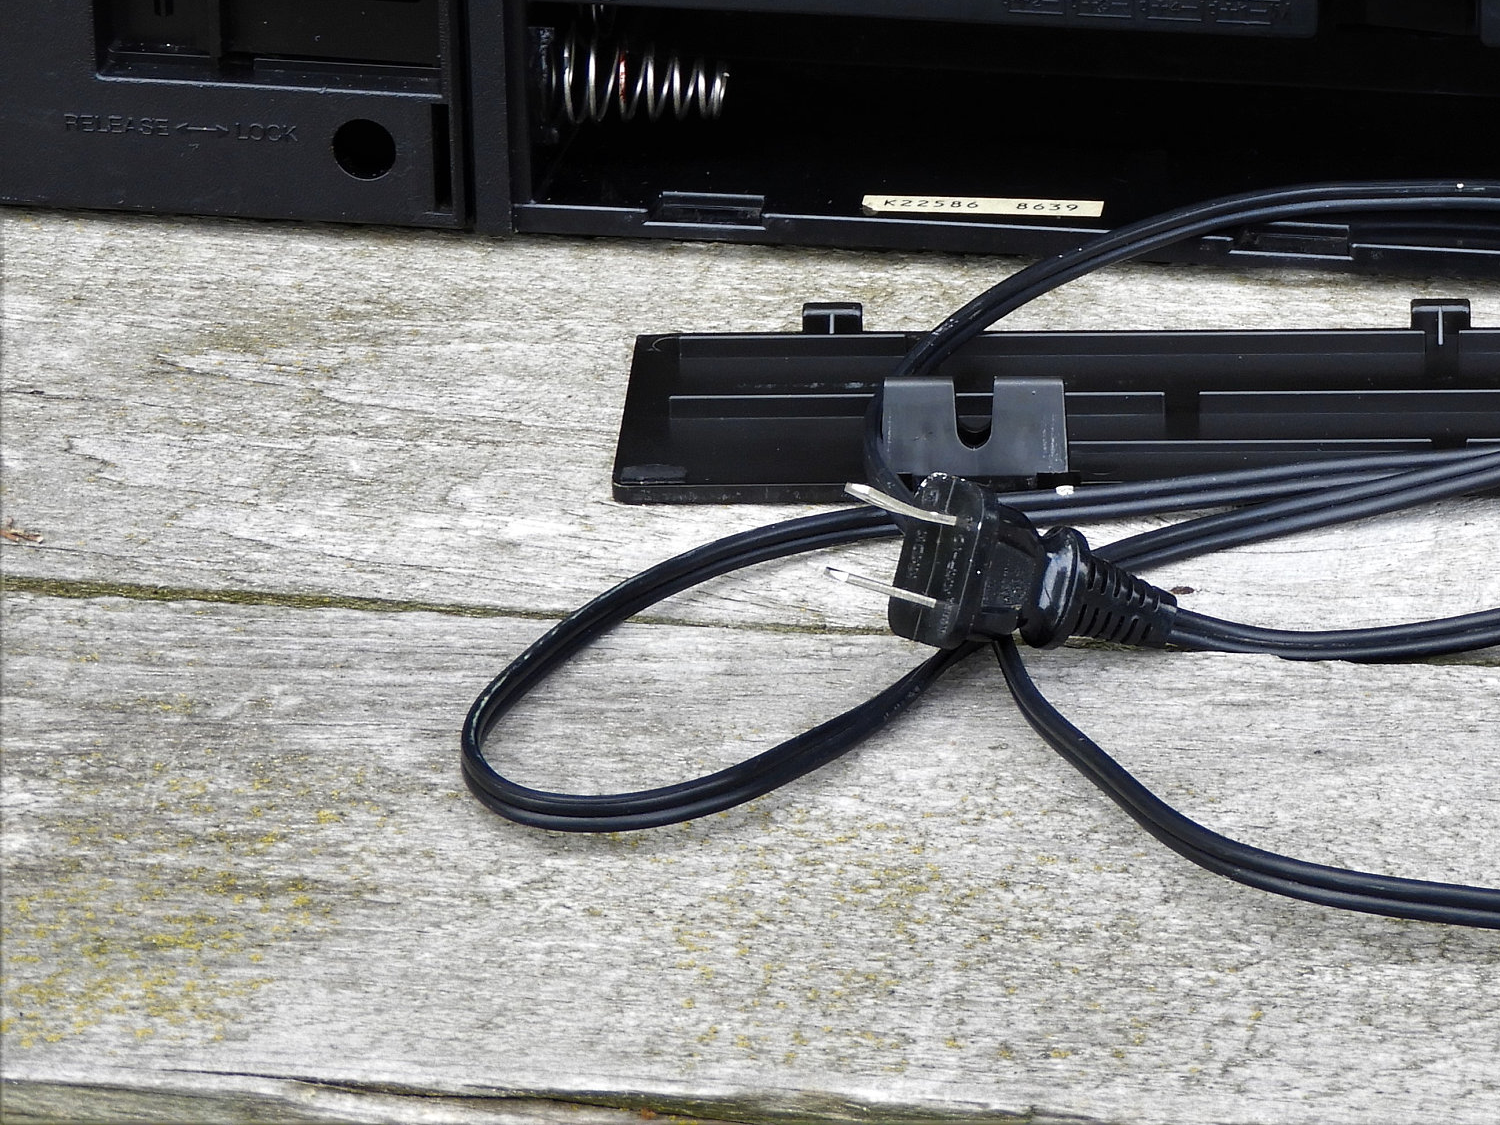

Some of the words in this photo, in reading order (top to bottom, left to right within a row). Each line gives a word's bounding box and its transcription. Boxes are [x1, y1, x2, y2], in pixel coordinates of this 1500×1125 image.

[63, 112, 170, 137] RELEASE
[236, 121, 299, 143] LOCK
[883, 198, 980, 210] K22586
[1015, 201, 1080, 213] 8639
